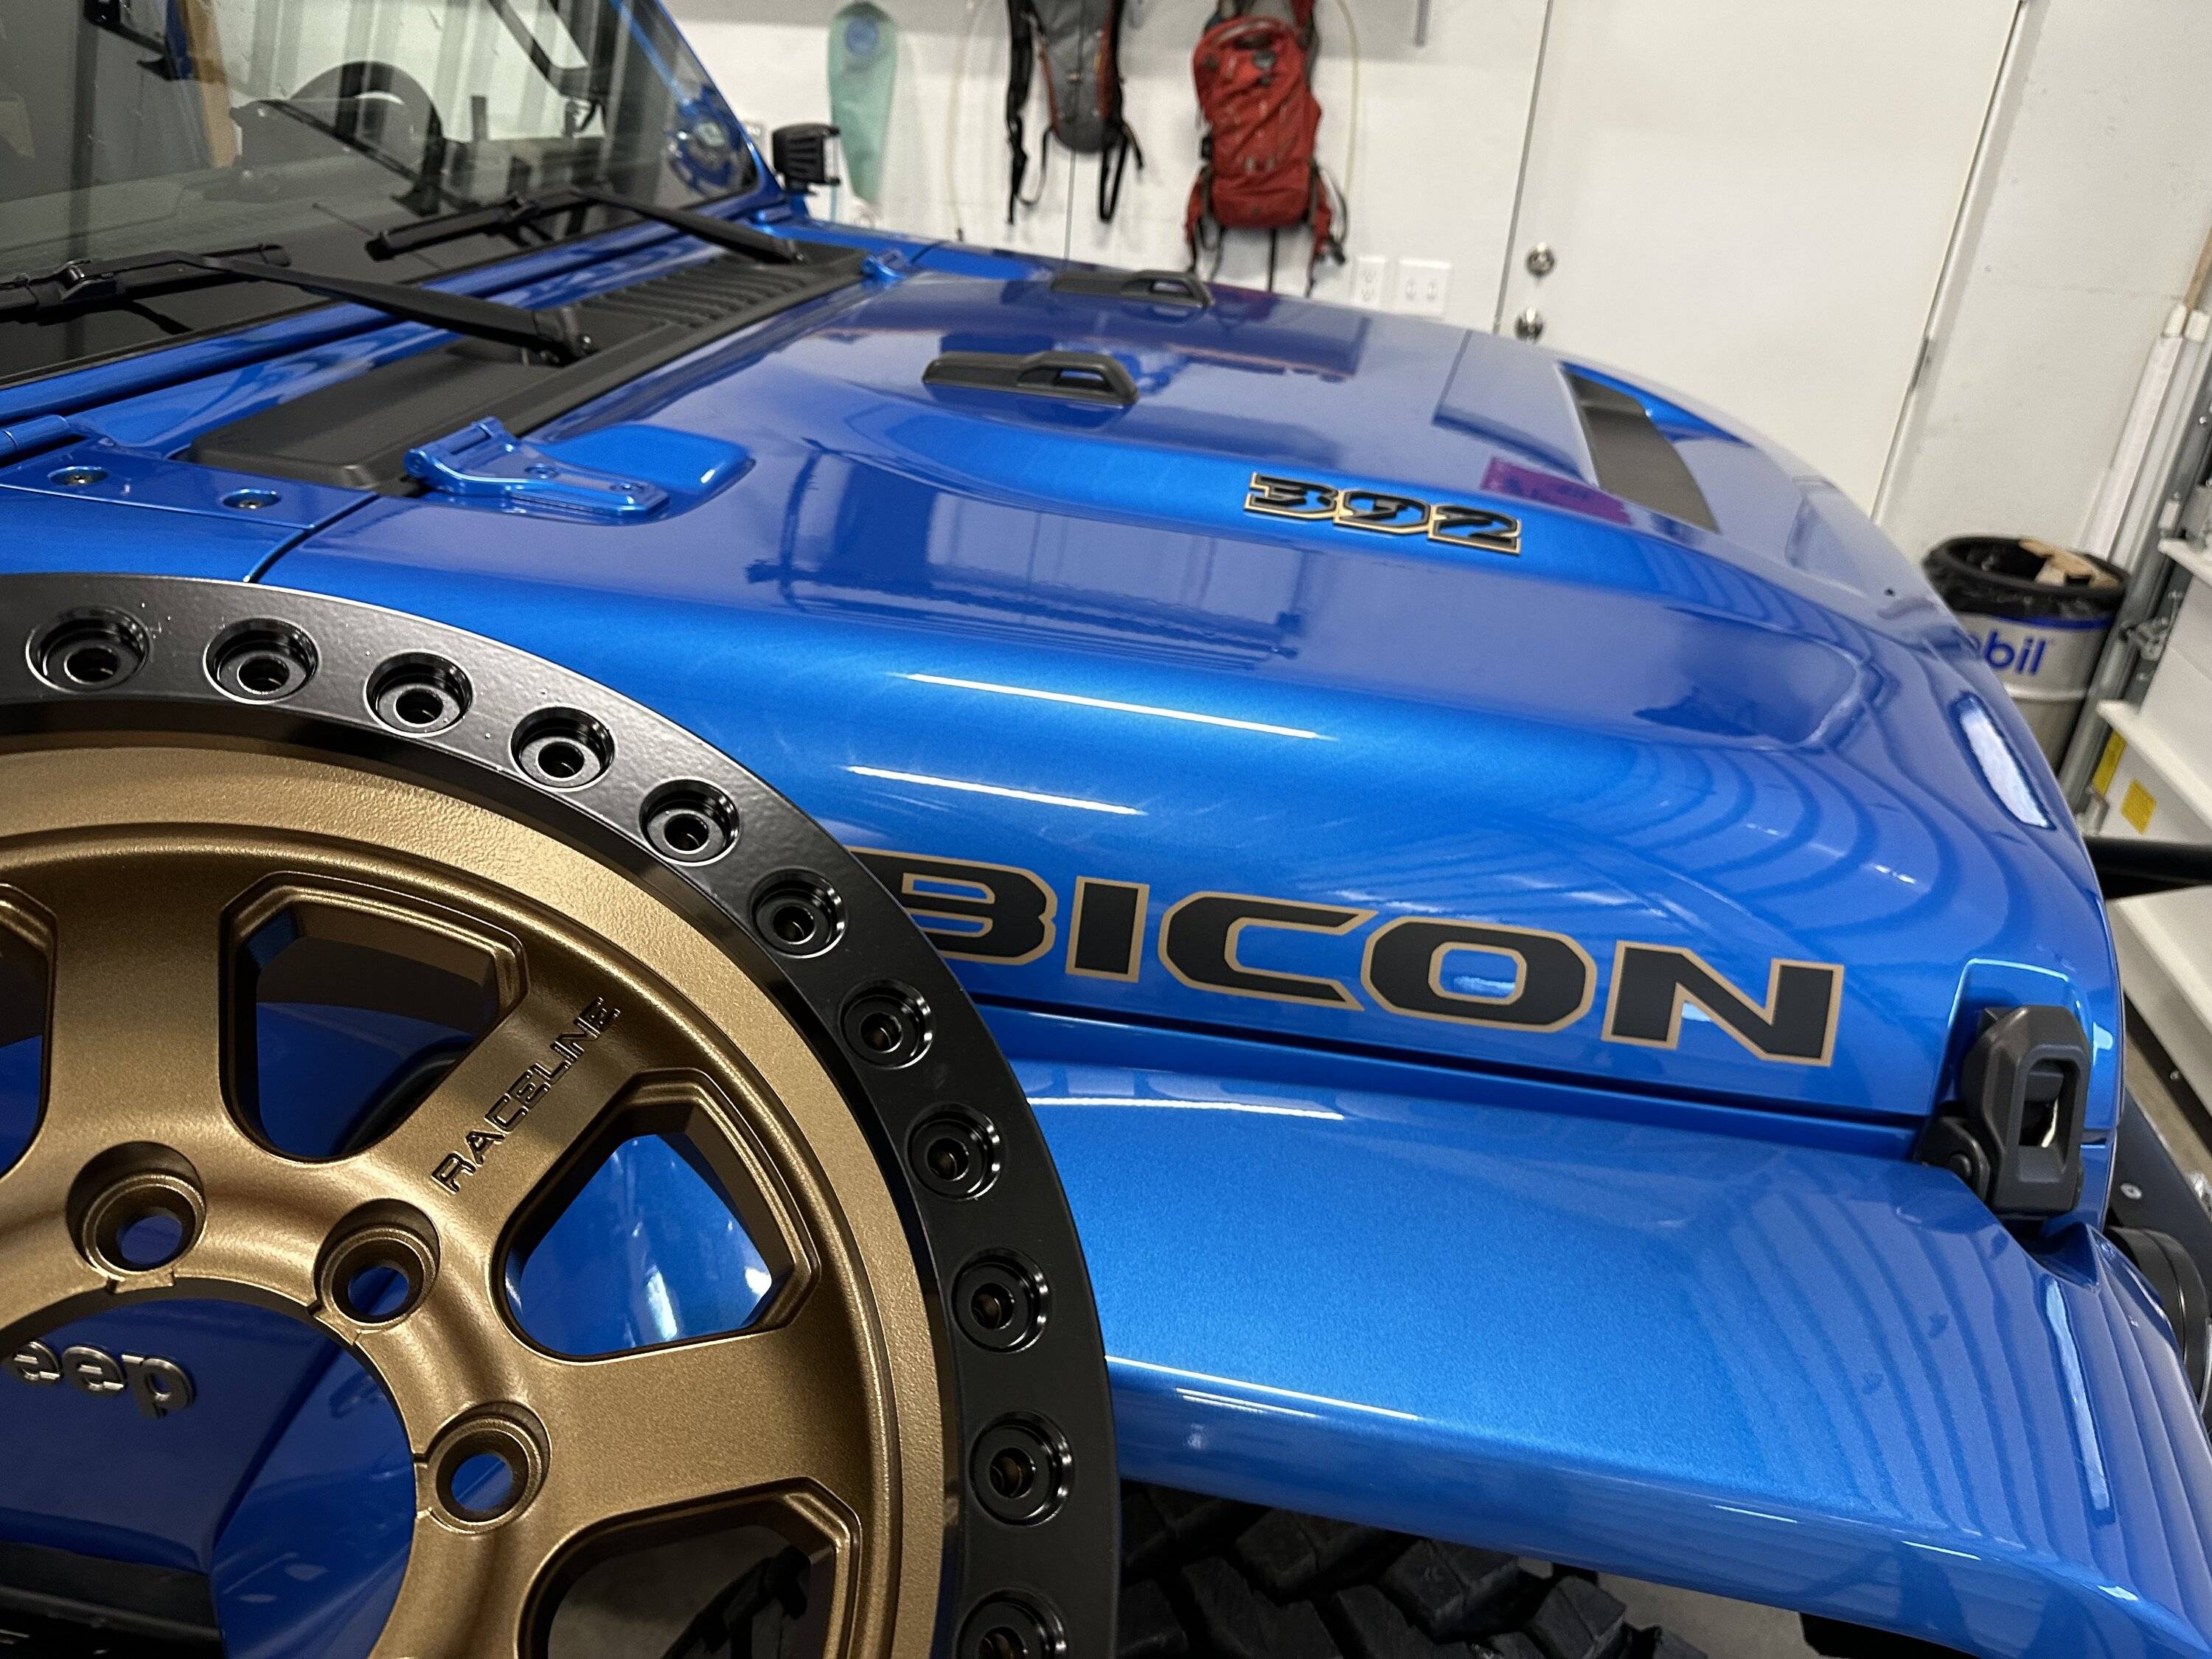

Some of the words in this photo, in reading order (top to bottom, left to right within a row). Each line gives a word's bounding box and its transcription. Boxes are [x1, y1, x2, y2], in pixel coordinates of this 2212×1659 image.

[1242, 471, 1522, 555] 392
[1970, 629, 2047, 676] bil
[431, 996, 621, 1195] RACELINE
